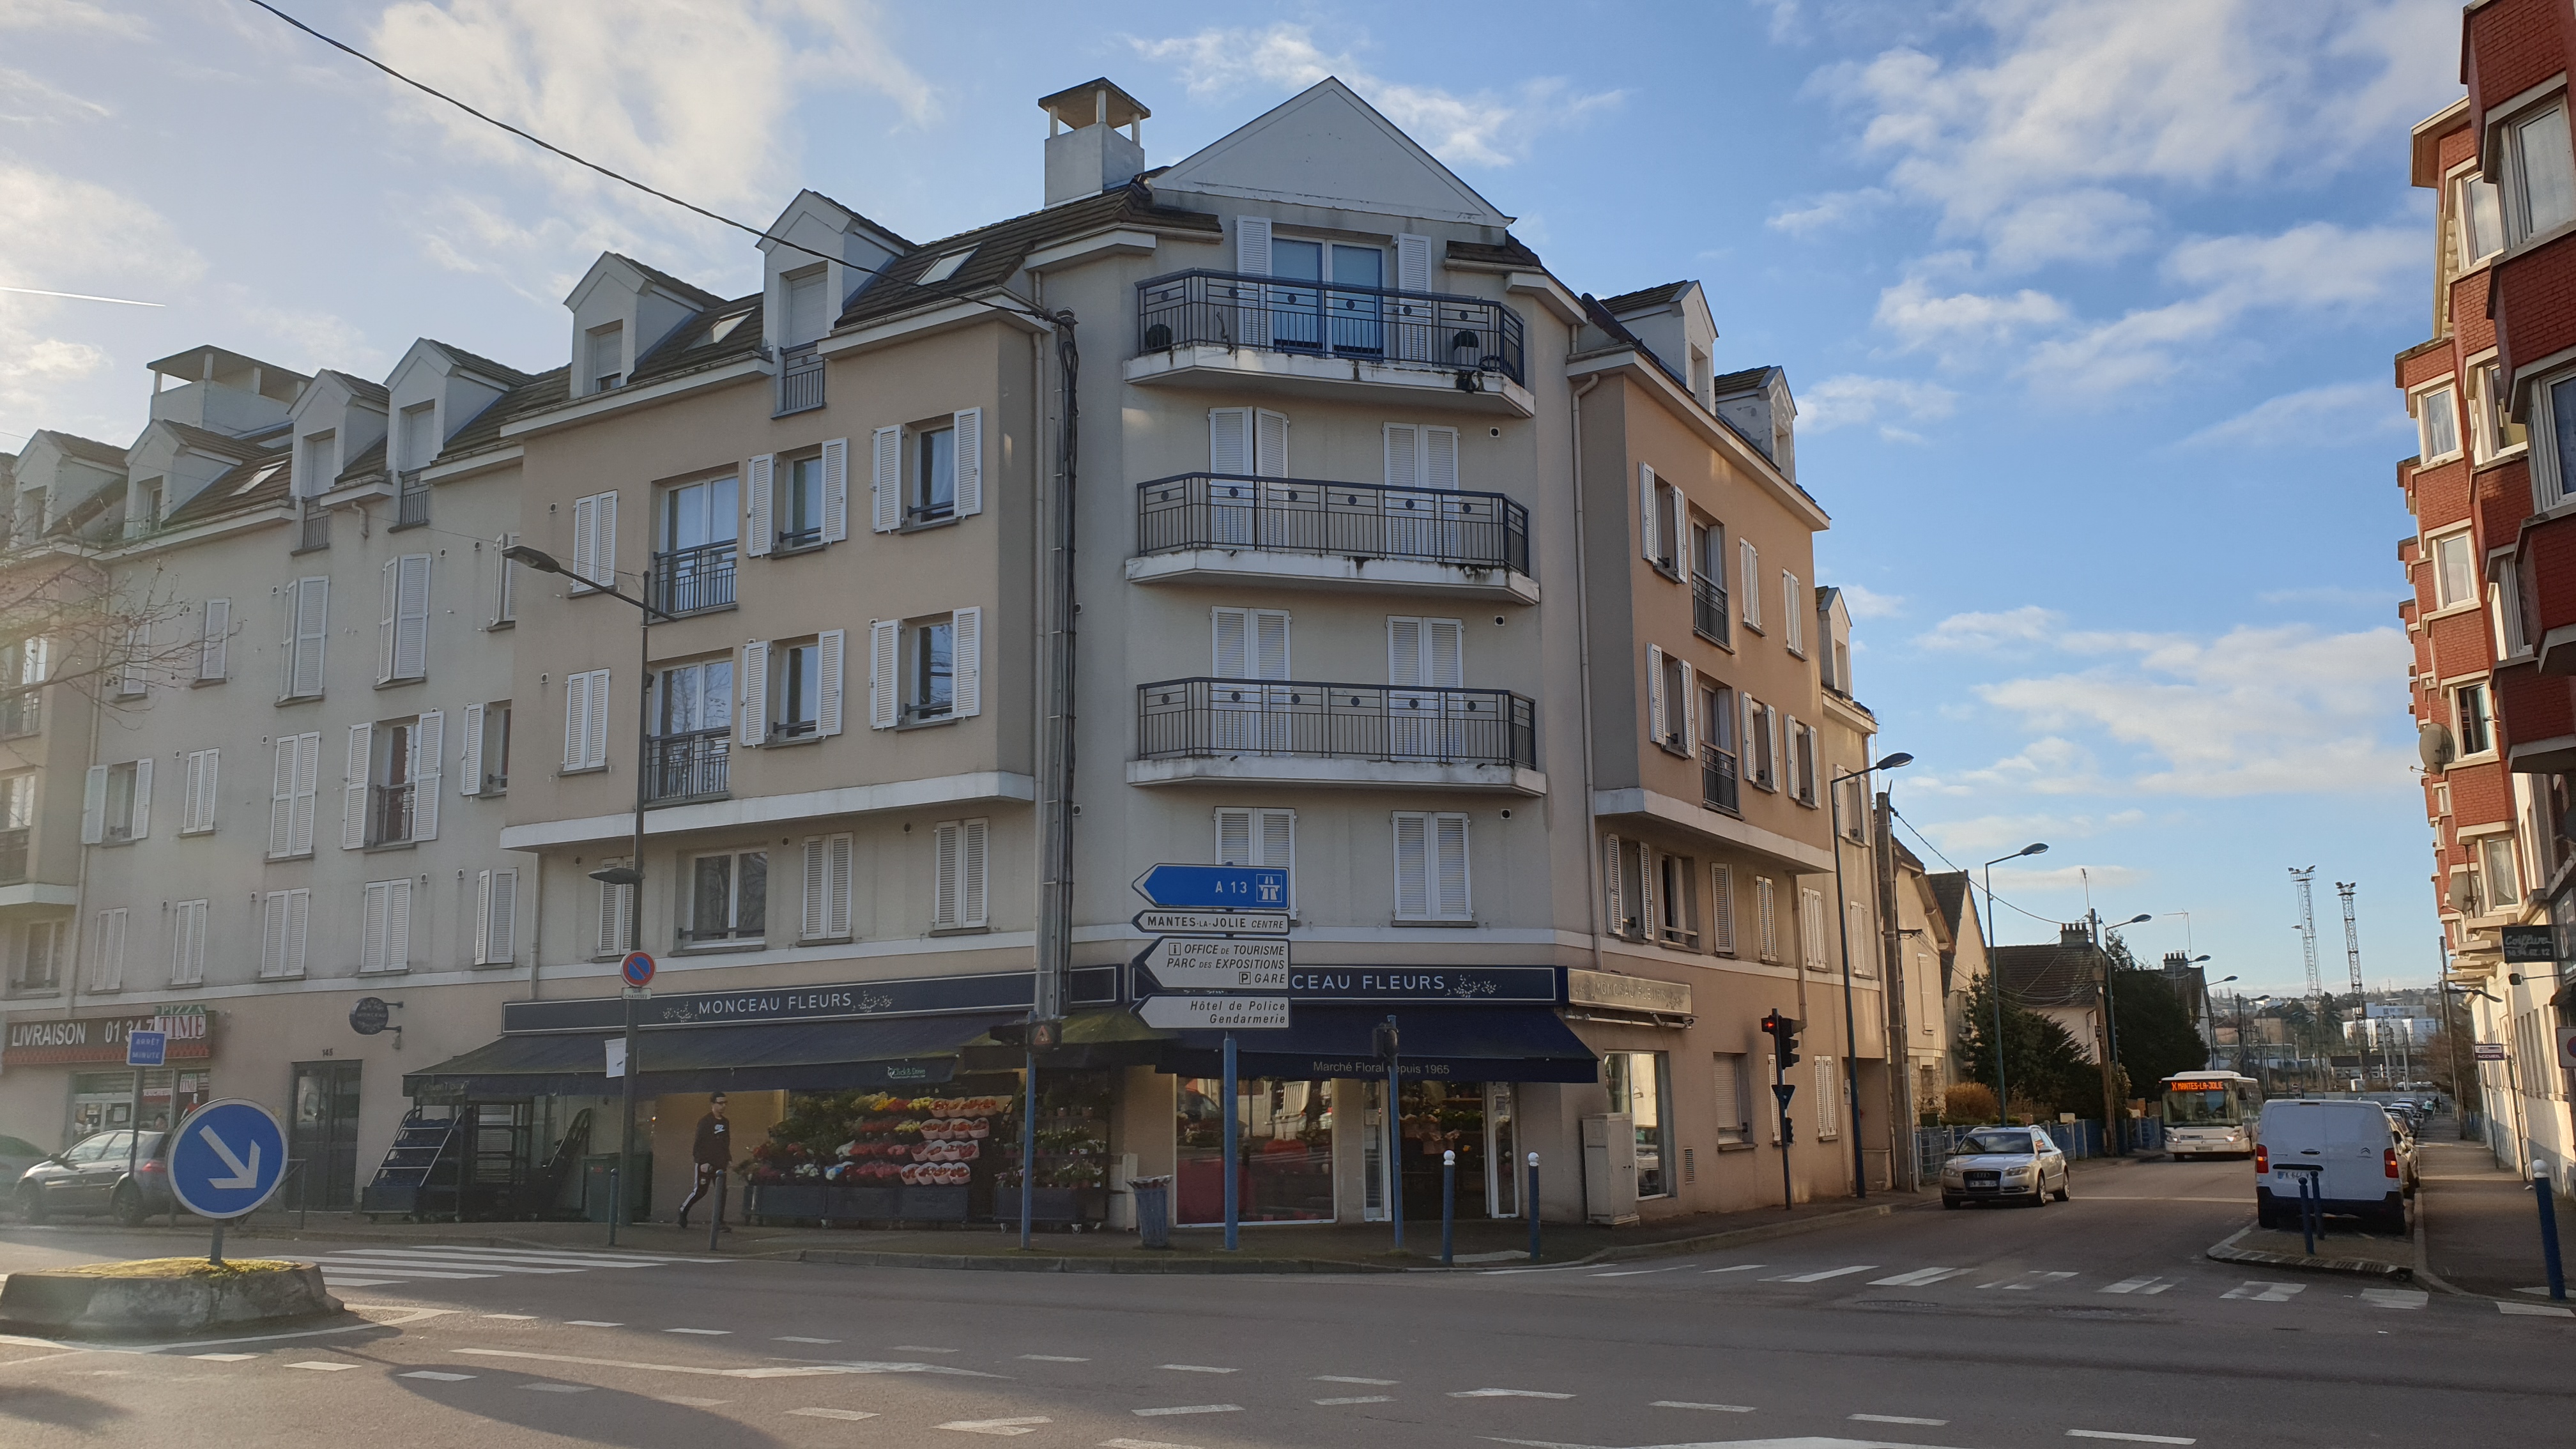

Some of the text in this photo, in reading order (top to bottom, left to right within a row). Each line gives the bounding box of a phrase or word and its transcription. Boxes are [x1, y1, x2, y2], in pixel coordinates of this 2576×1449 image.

[1215, 881, 1247, 894] A 13
[1147, 916, 1284, 928] MANTES-LA-JOLIE CENTRE
[1184, 944, 1218, 954] OFFICE
[1234, 945, 1285, 956] TOURISME
[1167, 958, 1196, 969] PARC
[1215, 959, 1285, 970] EXPOSITIONS
[1254, 973, 1285, 984] GARE
[1291, 974, 1445, 990] CEAU FLEURS
[699, 993, 851, 1014] MONCEAU FLEURS
[1190, 1000, 1285, 1011] Hôtel de Police
[160, 1005, 204, 1015] PIZZA
[1209, 1014, 1285, 1024] Gendarmerie
[12, 1022, 86, 1046] LIVRAISON
[105, 1020, 120, 1043] 01
[159, 1016, 204, 1038] TIME
[135, 1038, 160, 1046] ARRÊT
[1313, 1061, 1450, 1075] Marché Floral epuis 1965
